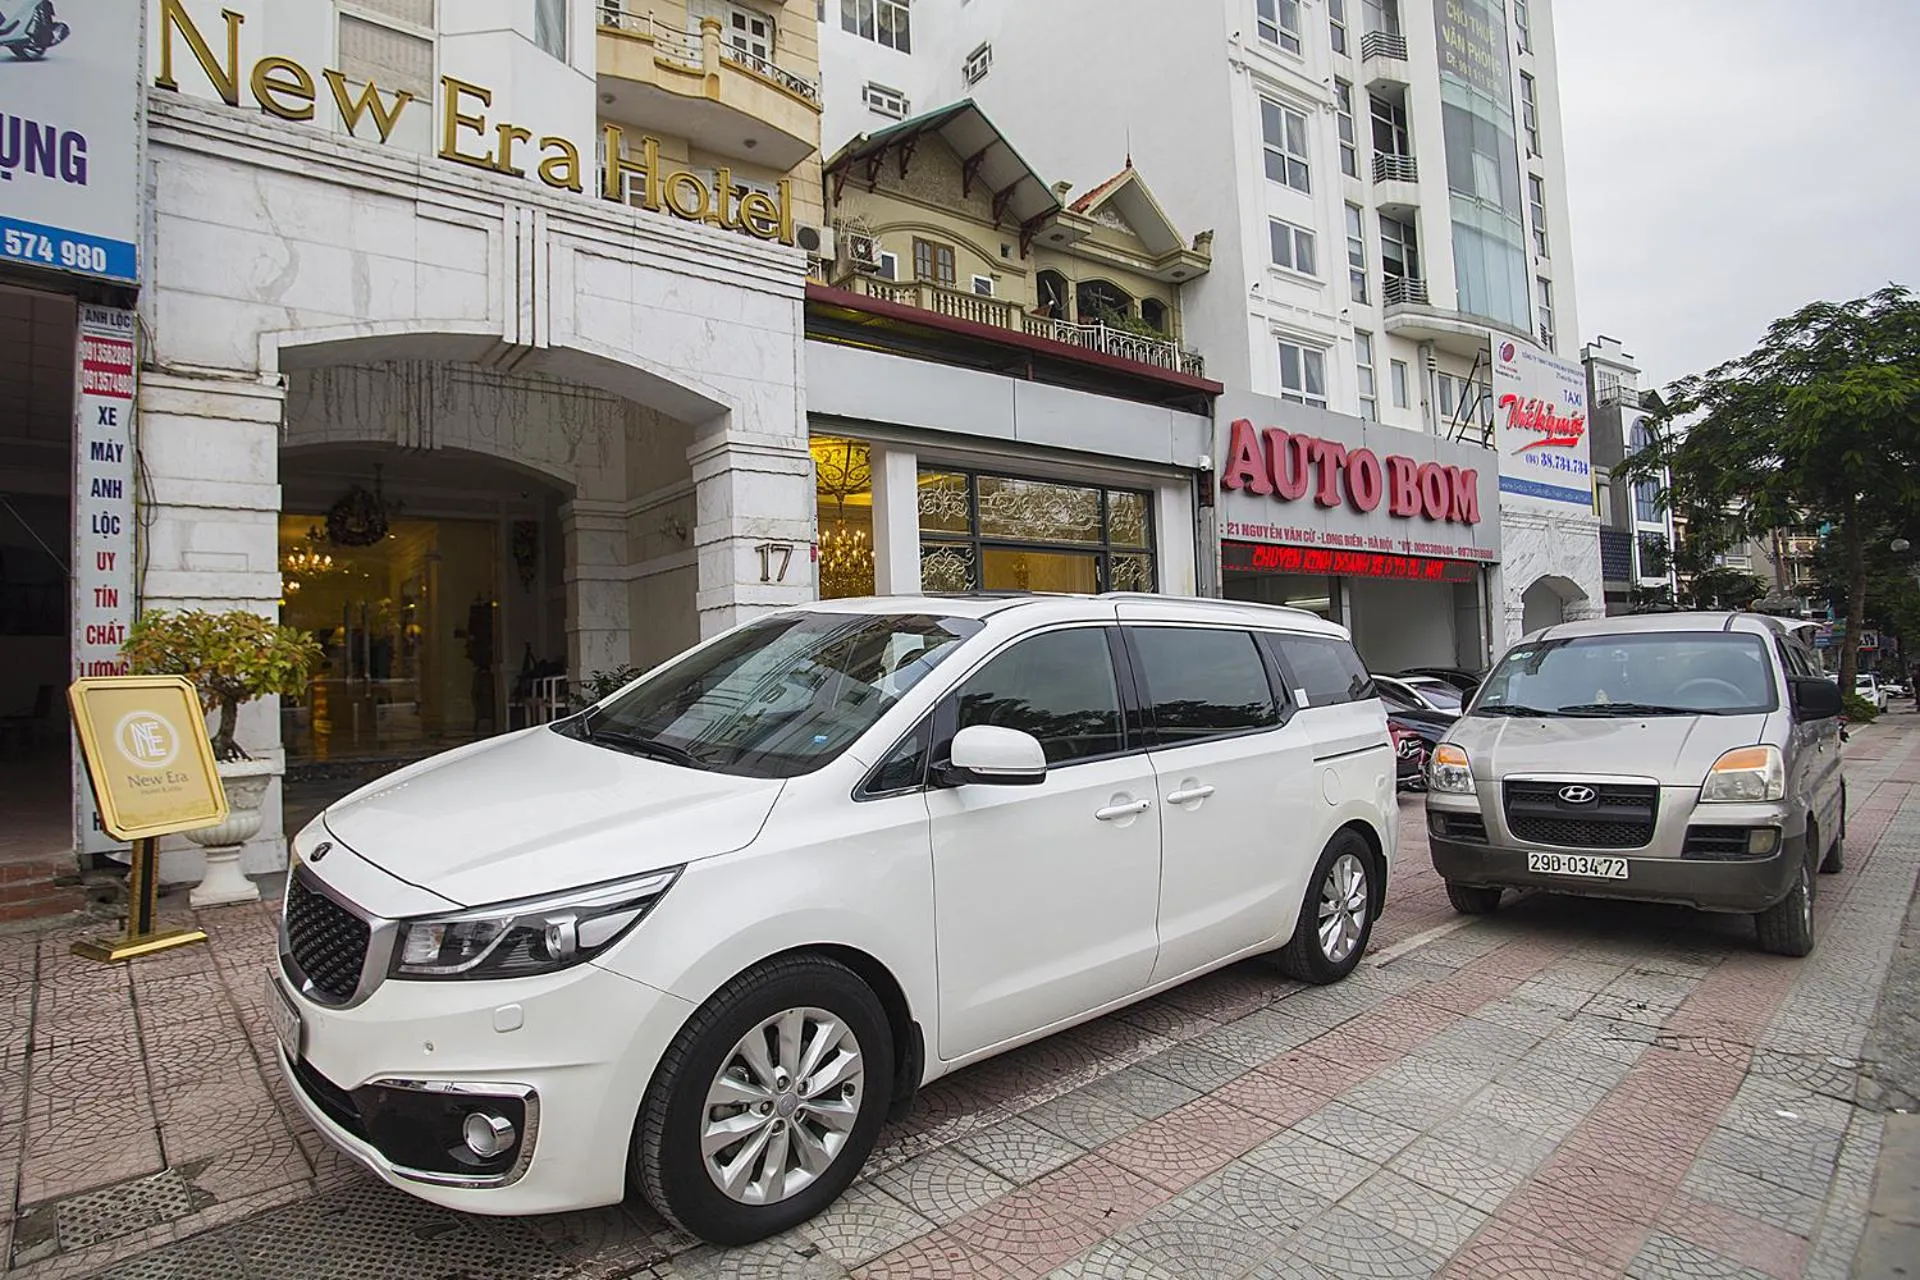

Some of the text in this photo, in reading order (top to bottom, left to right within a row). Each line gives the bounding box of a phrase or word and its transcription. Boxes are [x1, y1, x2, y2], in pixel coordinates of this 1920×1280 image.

[154, 0, 794, 246] New Era Hotel
[4, 228, 107, 272] 574 980
[85, 308, 107, 325] ANH
[1563, 389, 1582, 407] TAXI
[98, 406, 117, 426] XE
[1221, 418, 1481, 525] AUTO BOM
[91, 478, 122, 499] ANH
[92, 511, 120, 539] LỘC
[1227, 522, 1240, 535] 21
[96, 552, 116, 571] UY
[754, 543, 794, 582] 17
[94, 584, 118, 608] TÍN
[86, 618, 125, 645] CHẤT
[127, 770, 189, 788] New Era
